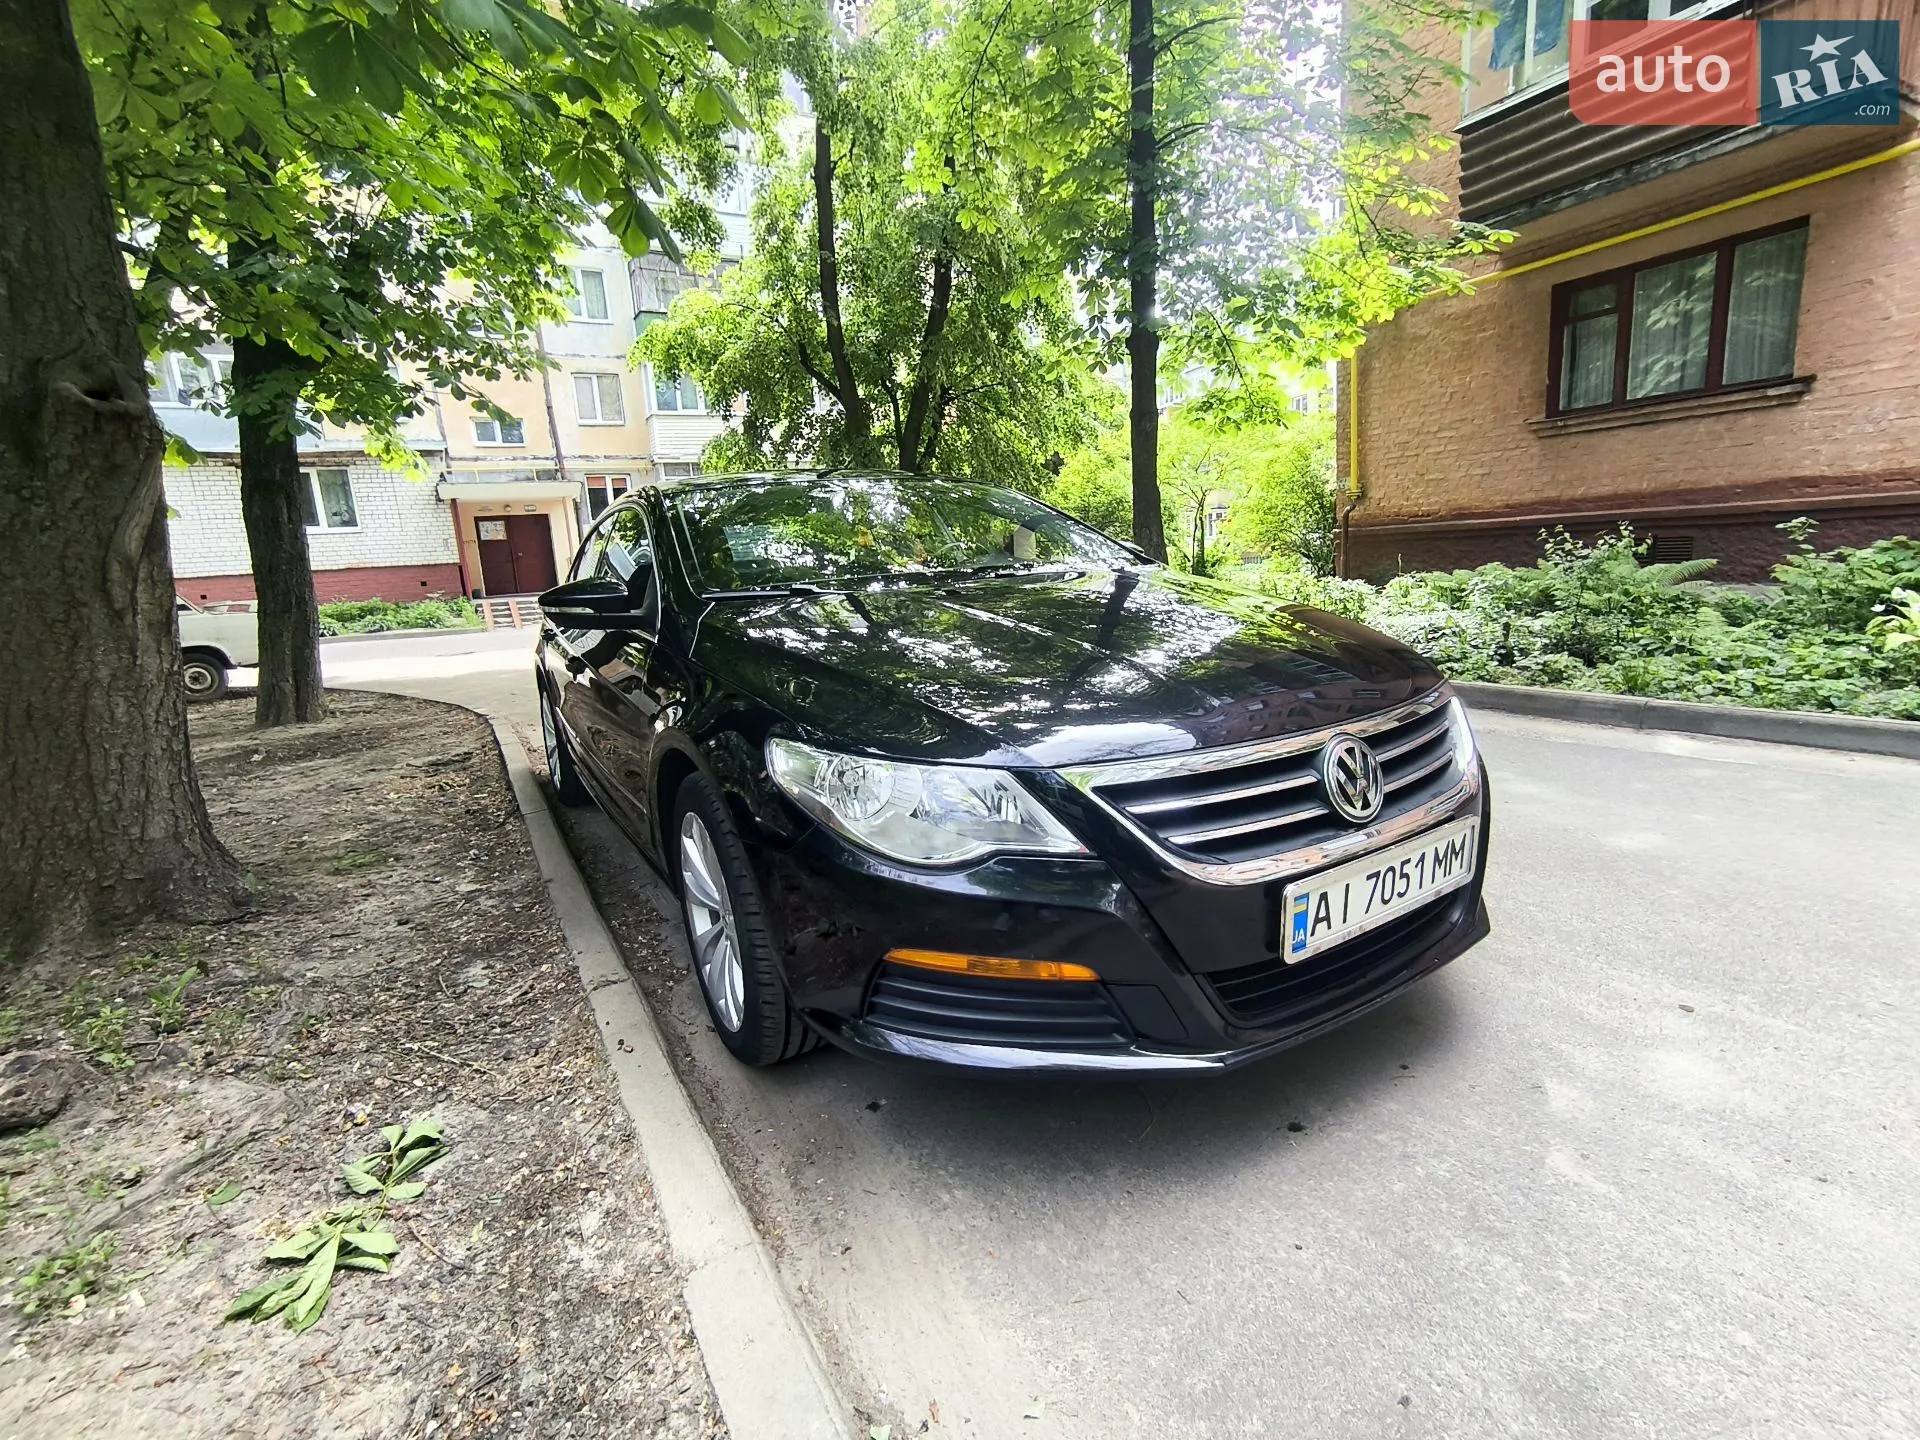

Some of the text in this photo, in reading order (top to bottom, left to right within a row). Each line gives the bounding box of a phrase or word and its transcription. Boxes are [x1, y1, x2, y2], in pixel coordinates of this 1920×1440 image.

[1309, 833, 1467, 937] AI 7051 MM
